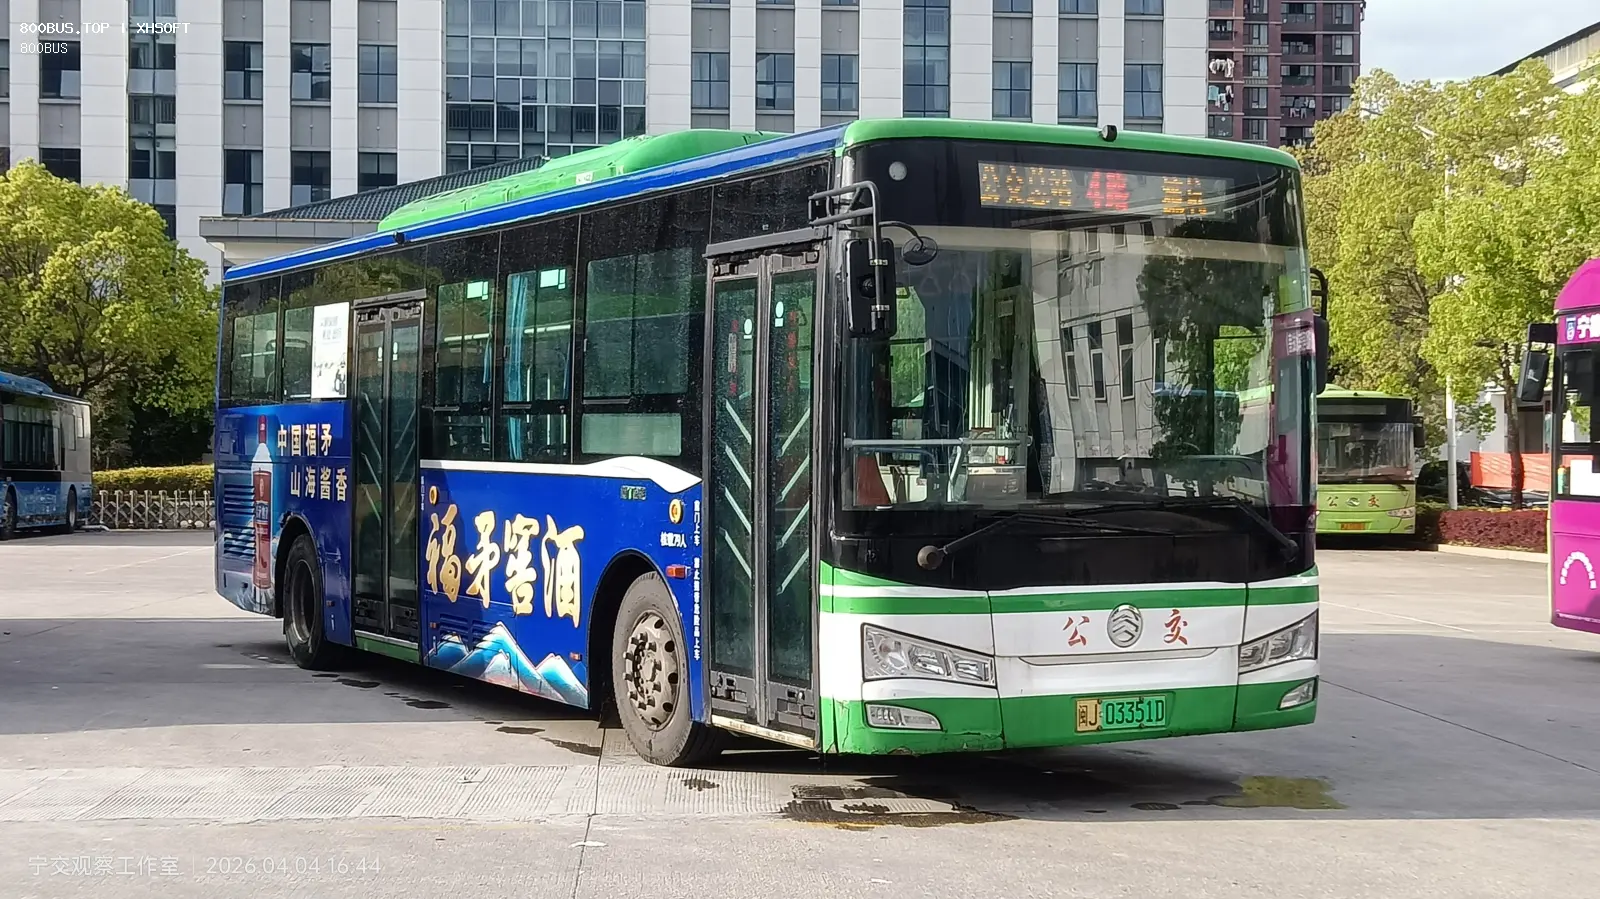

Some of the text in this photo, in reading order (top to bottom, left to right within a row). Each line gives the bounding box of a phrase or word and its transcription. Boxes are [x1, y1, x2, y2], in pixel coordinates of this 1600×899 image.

[277, 423, 332, 456] 中国福矛
[290, 464, 348, 502] 山海酱香
[425, 503, 585, 629] 福矛窖酒
[1063, 609, 1188, 647] 公 交
[1105, 699, 1165, 725] 03351D
